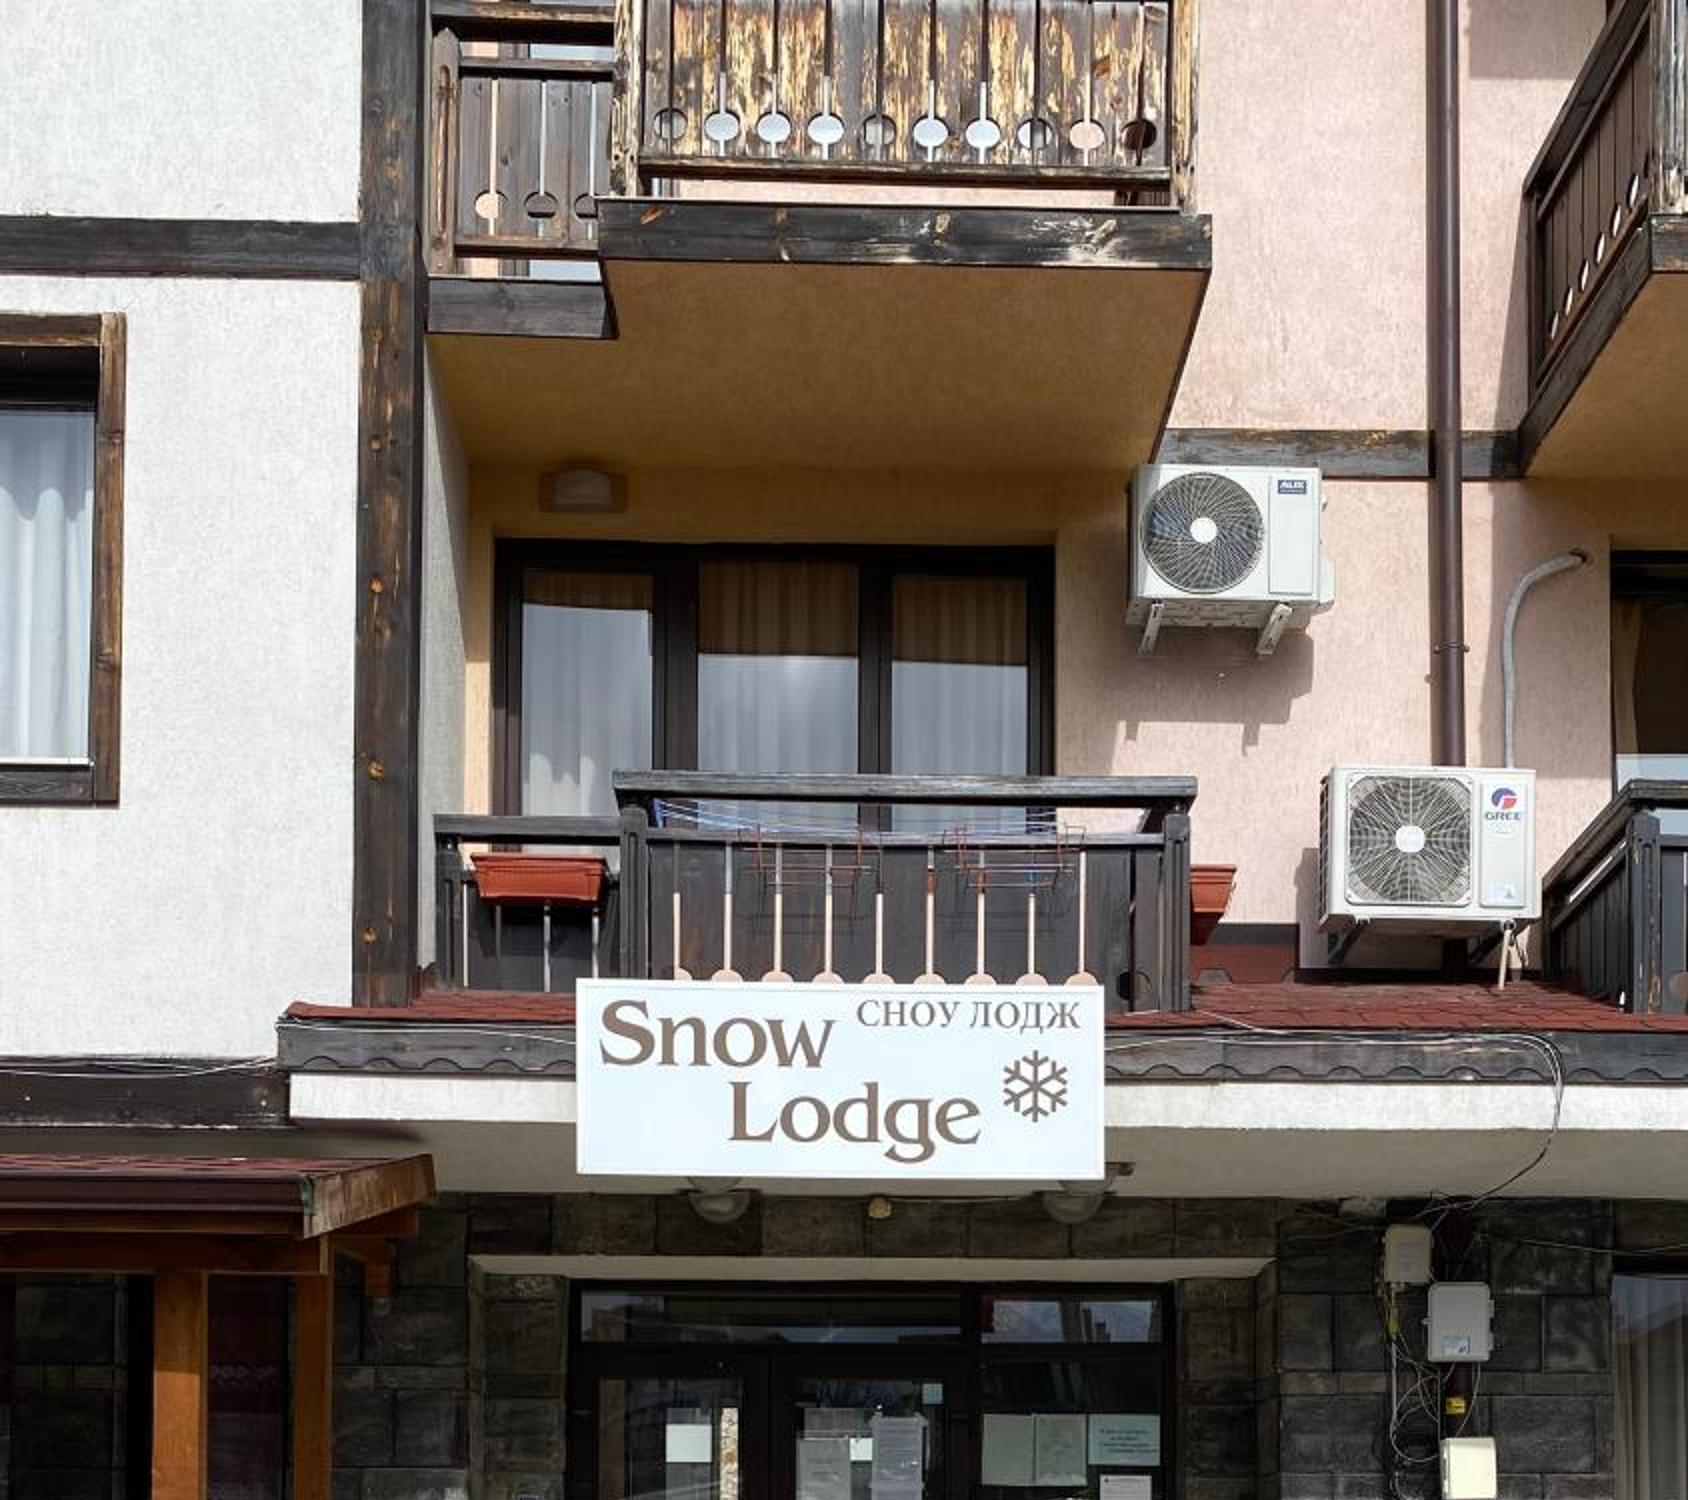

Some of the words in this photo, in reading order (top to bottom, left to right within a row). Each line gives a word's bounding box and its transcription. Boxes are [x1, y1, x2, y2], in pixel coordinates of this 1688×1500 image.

[1484, 811, 1523, 821] GREE
[600, 1000, 835, 1068] Snow
[857, 1000, 960, 1027] СНОУ
[970, 1002, 1079, 1033] ЛОДЖ
[728, 1082, 980, 1163] Lodge
